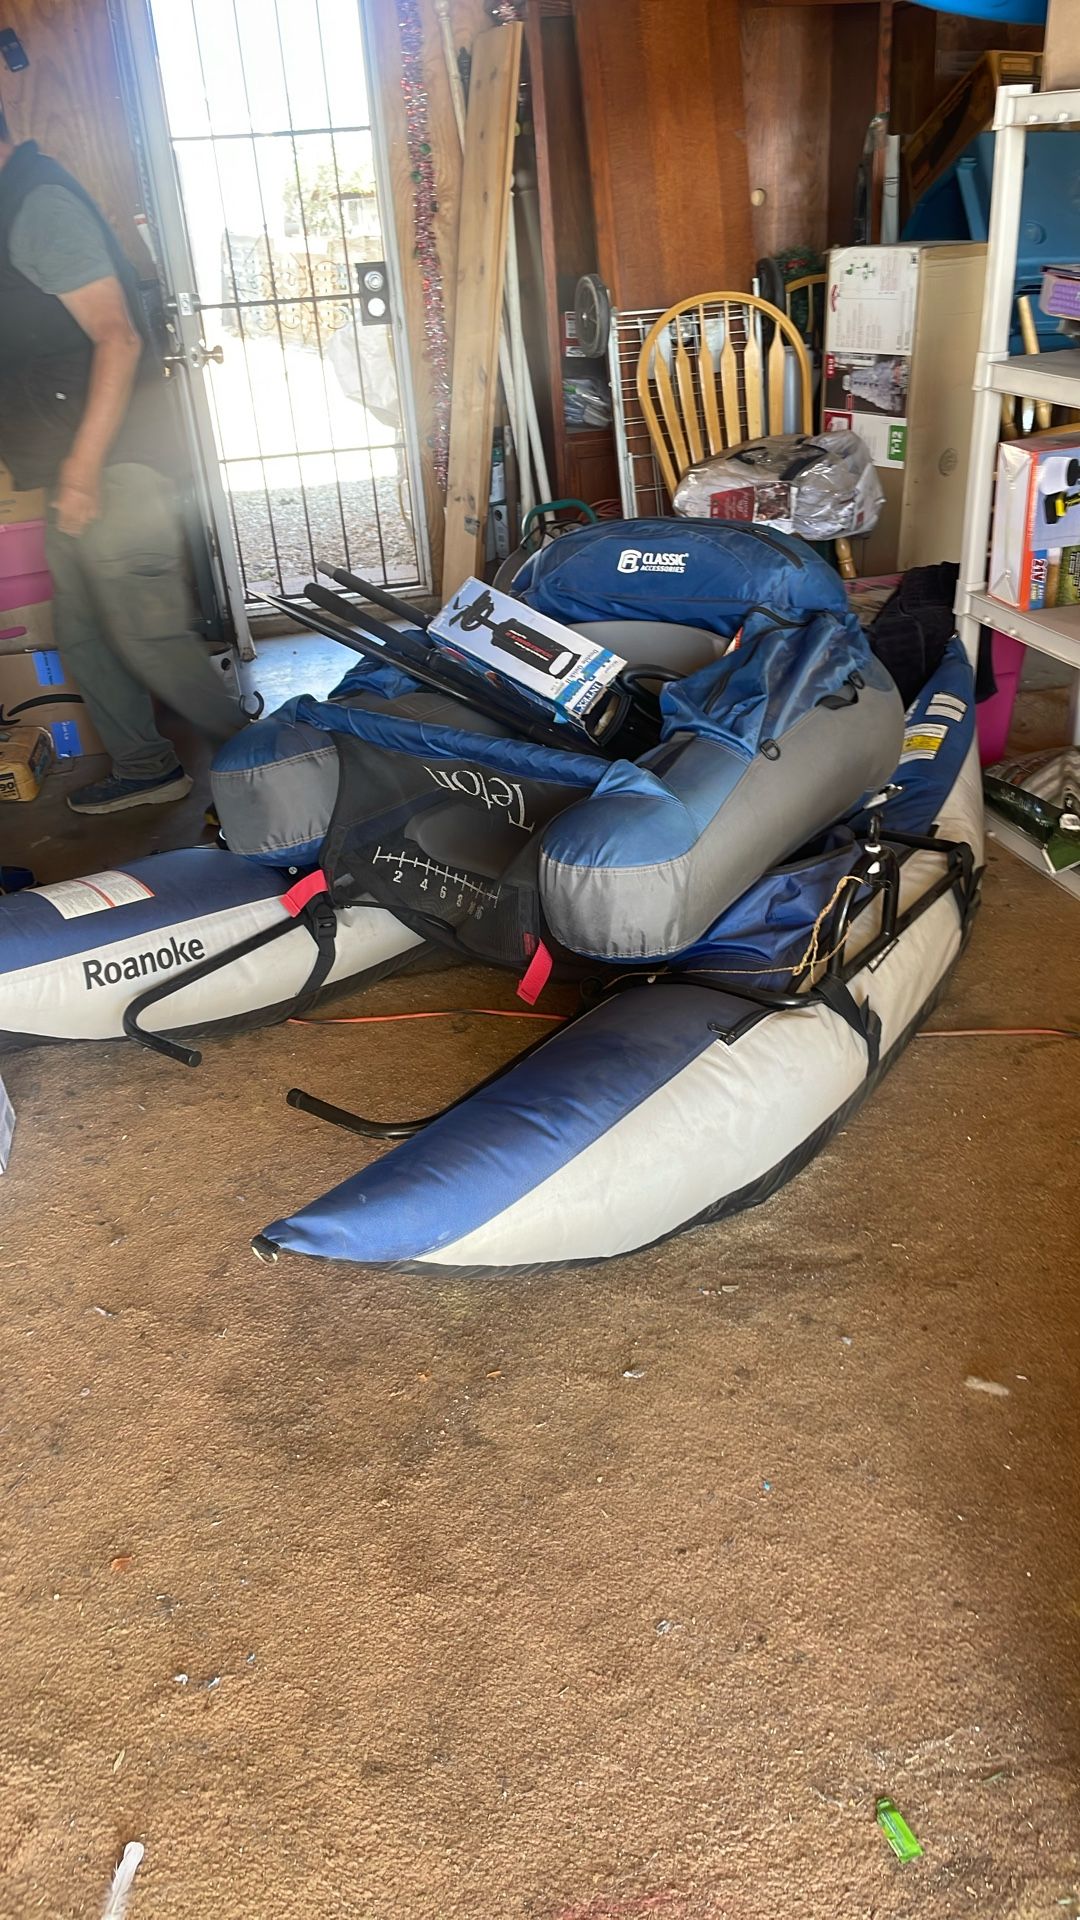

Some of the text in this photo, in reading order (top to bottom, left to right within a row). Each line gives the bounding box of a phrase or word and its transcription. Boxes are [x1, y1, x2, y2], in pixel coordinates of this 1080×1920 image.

[640, 565, 685, 573] ACCESSORIES
[1031, 558, 1047, 583] 21V
[575, 681, 603, 709] INTEX
[422, 765, 535, 833] Teton
[392, 870, 403, 883] 2
[419, 878, 429, 891] 4
[440, 886, 447, 899] 6
[82, 936, 206, 990] Roanoke
